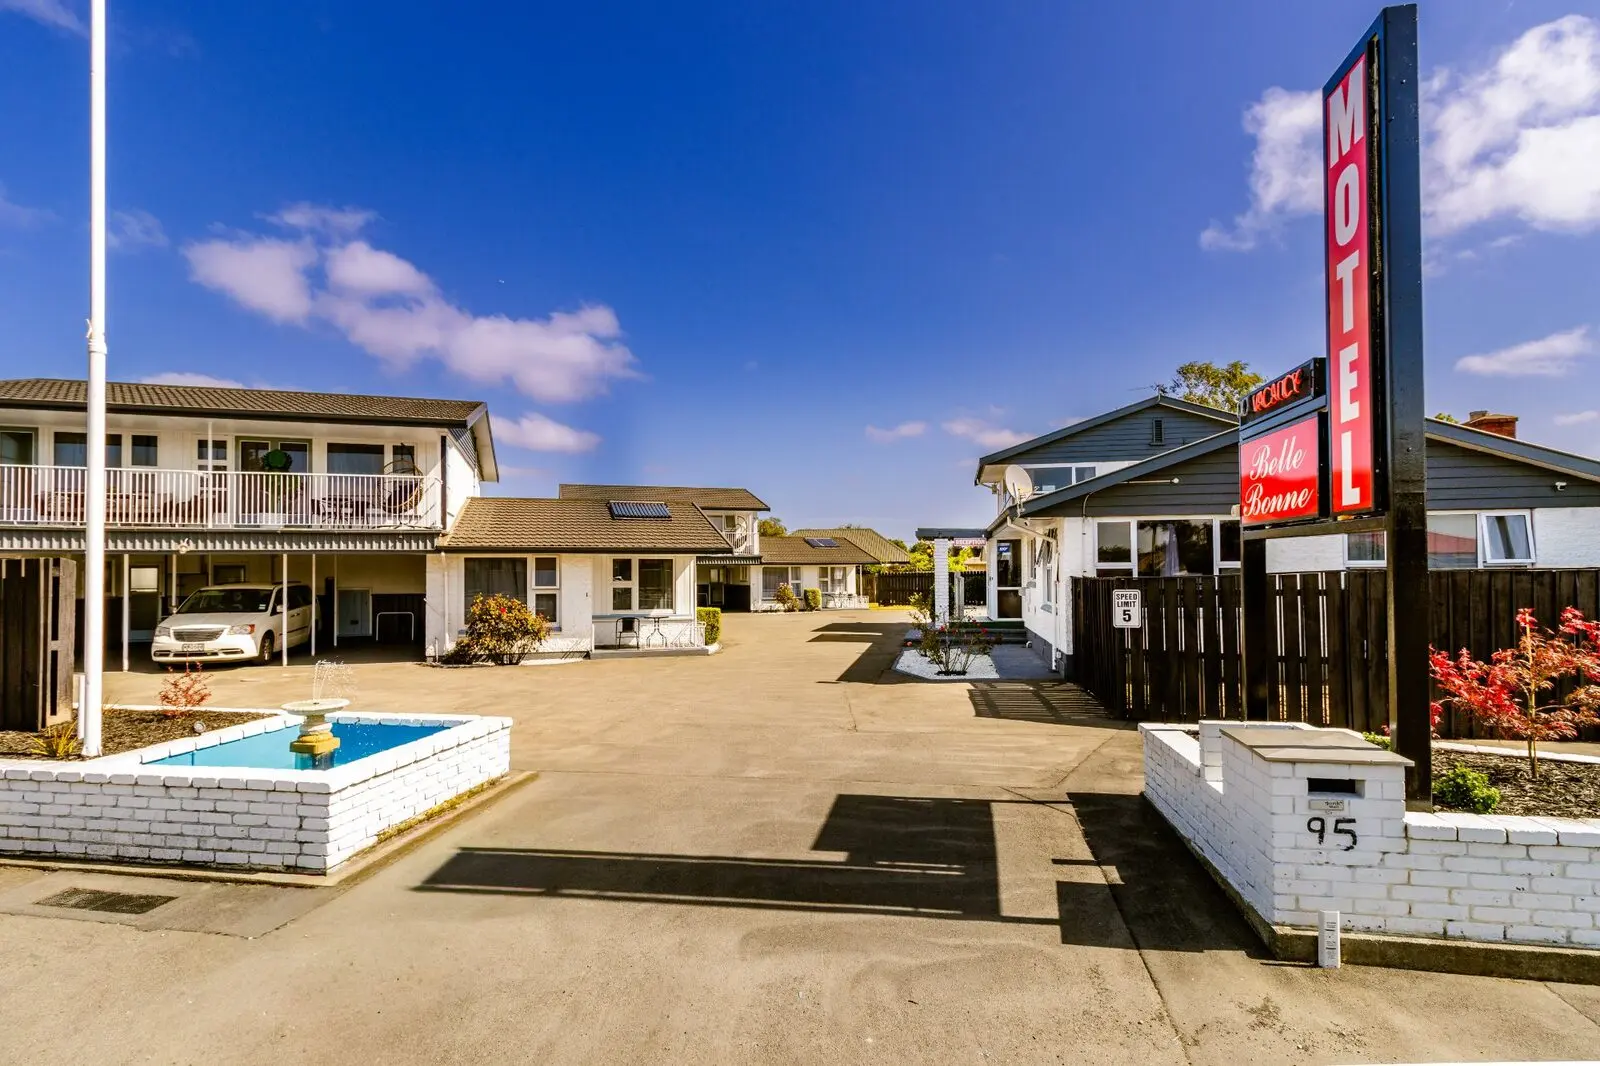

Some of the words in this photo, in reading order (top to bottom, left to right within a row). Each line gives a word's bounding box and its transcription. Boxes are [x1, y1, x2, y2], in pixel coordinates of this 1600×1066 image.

[1330, 60, 1363, 506] MOTEL
[1252, 368, 1304, 412] VACANCY
[1250, 436, 1306, 480] Belle
[1243, 483, 1313, 517] Bonne
[1122, 609, 1131, 622] 5
[1307, 816, 1357, 851] 95
